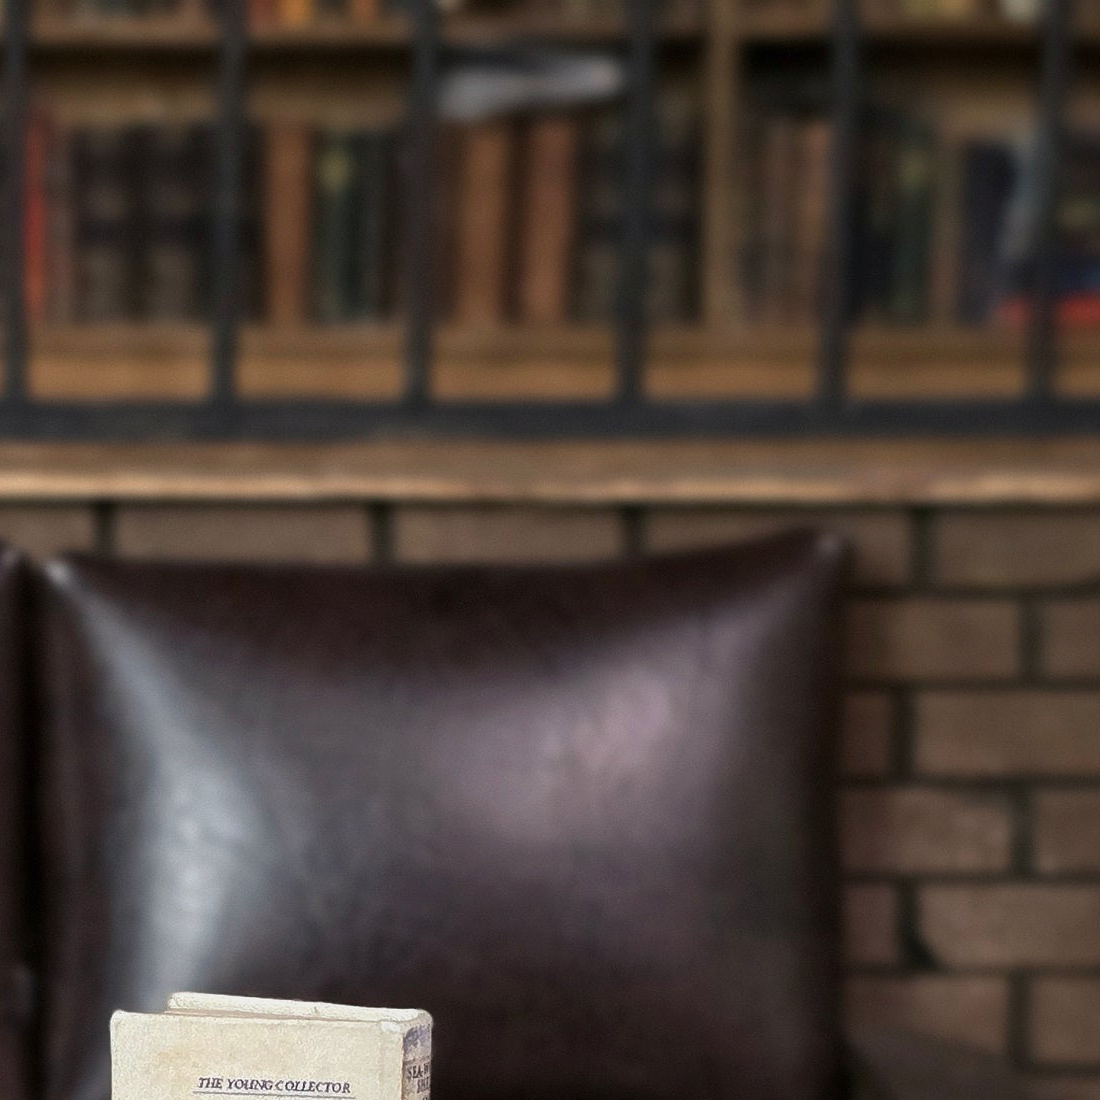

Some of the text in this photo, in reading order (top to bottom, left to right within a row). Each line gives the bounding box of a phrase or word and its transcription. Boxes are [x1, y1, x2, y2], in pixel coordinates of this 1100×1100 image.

[199, 1077, 351, 1094] THE YOUNG COLLECTOR
